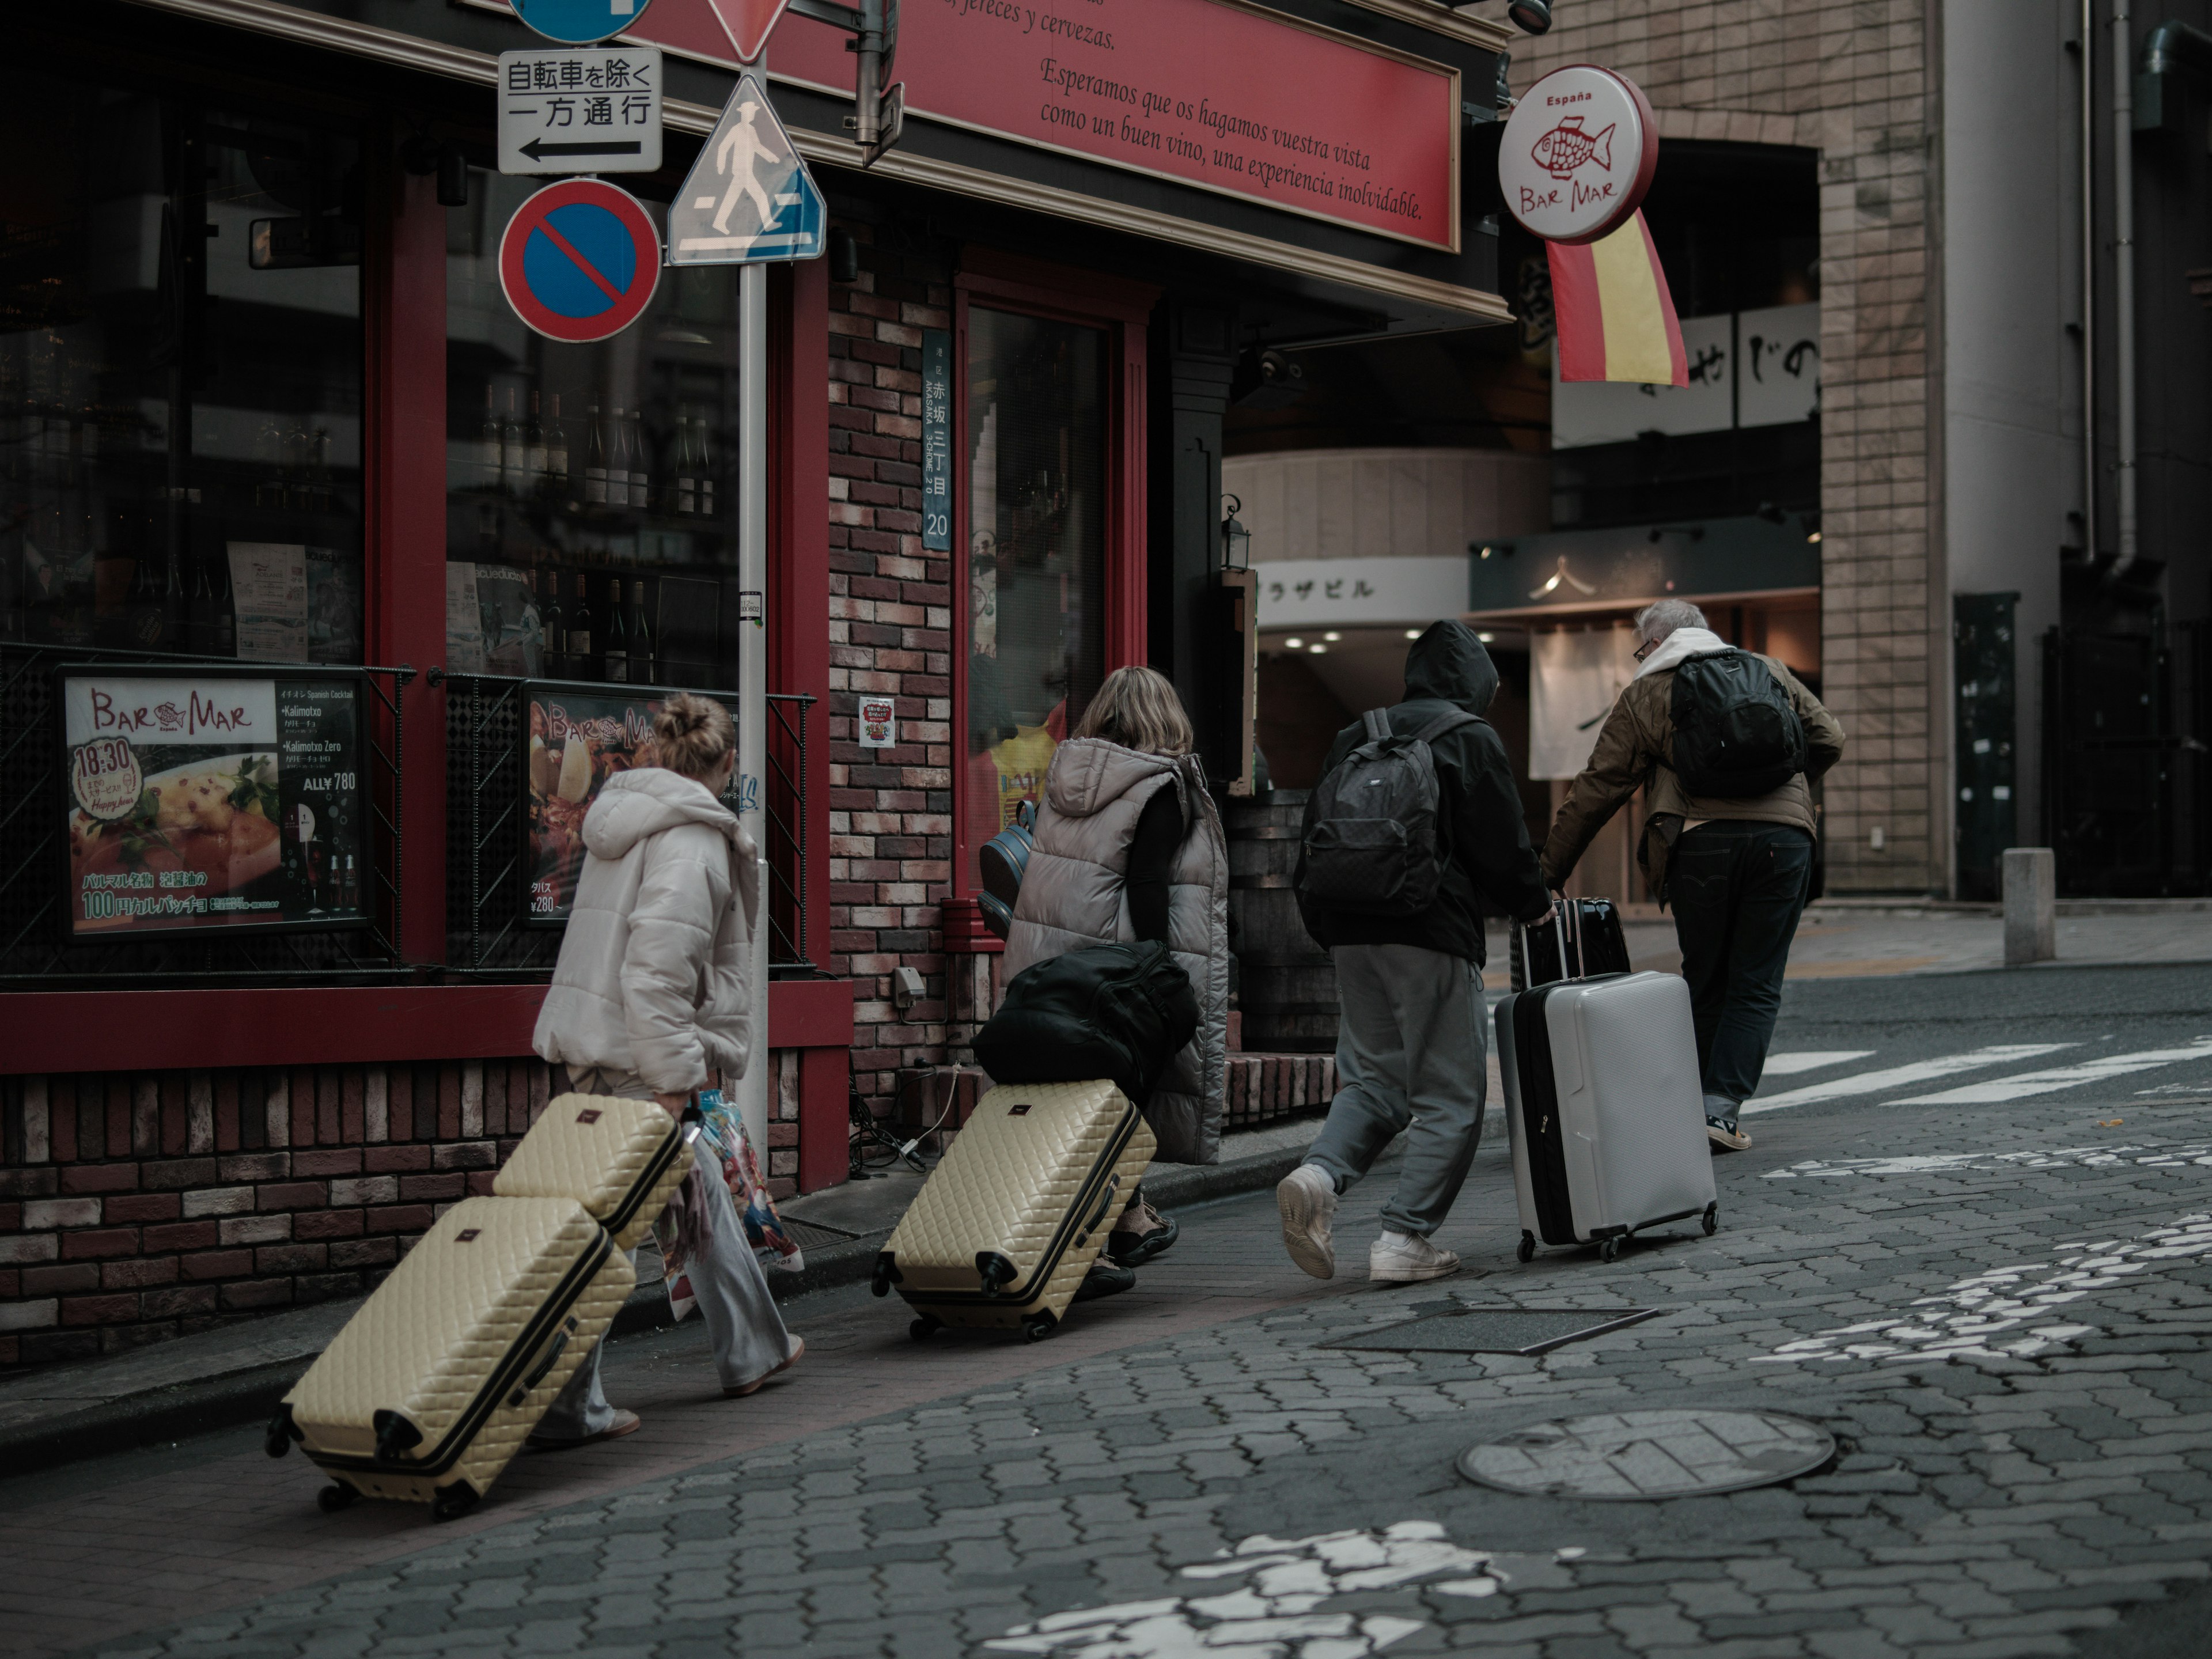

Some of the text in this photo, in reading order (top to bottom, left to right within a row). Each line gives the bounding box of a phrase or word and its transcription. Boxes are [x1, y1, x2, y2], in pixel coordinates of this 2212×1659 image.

[1022, 8, 1036, 34] y
[1040, 14, 1115, 50] cervezas.
[508, 59, 651, 90] 自転車を除く
[1546, 92, 1592, 107] España
[509, 97, 652, 127] 一方通行
[1040, 58, 1371, 171] Esperamos que os hagamos vuestra vista
[1041, 102, 1422, 220] como un buen vino, una experiencia inolvidable.
[933, 381, 946, 496] 赤坂三丁目
[925, 434, 933, 473] 3-CHOME
[927, 513, 948, 536] 20
[475, 568, 521, 582] acueducto
[1258, 578, 1375, 602] ラザビル
[307, 690, 329, 700] Spanish
[331, 690, 354, 699] Cocktail
[91, 687, 252, 735] BAR MAR
[285, 704, 322, 717] Kalimotxo
[285, 719, 316, 728] カリモーチョ
[548, 702, 657, 748] BAR MA
[286, 740, 342, 752] Kalimotxo Zero
[75, 740, 130, 778] 18:30
[87, 779, 105, 790] までの
[92, 796, 134, 813] Happy hour
[82, 872, 154, 889] バルマル名物
[531, 881, 551, 893] タパス
